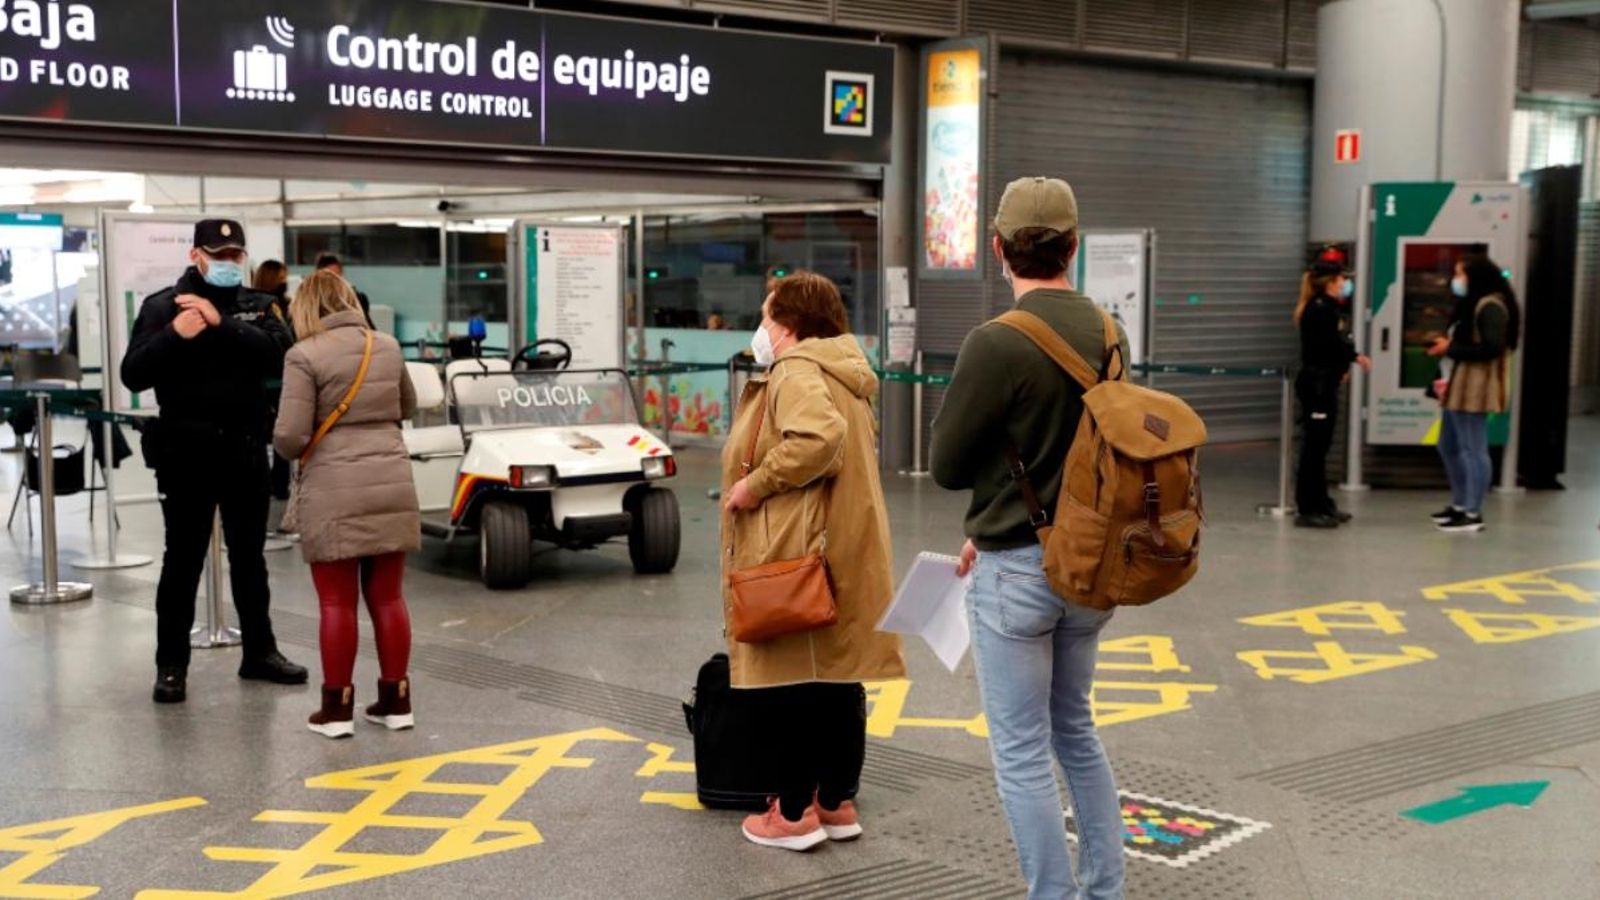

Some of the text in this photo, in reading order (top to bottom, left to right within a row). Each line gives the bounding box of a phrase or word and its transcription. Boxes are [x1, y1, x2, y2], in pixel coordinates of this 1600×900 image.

[30, 59, 130, 91] FLOOR
[327, 24, 711, 102] Control de equipaje
[328, 83, 533, 118] LUGGAGE CONTROL
[497, 385, 592, 408] POLICIA
